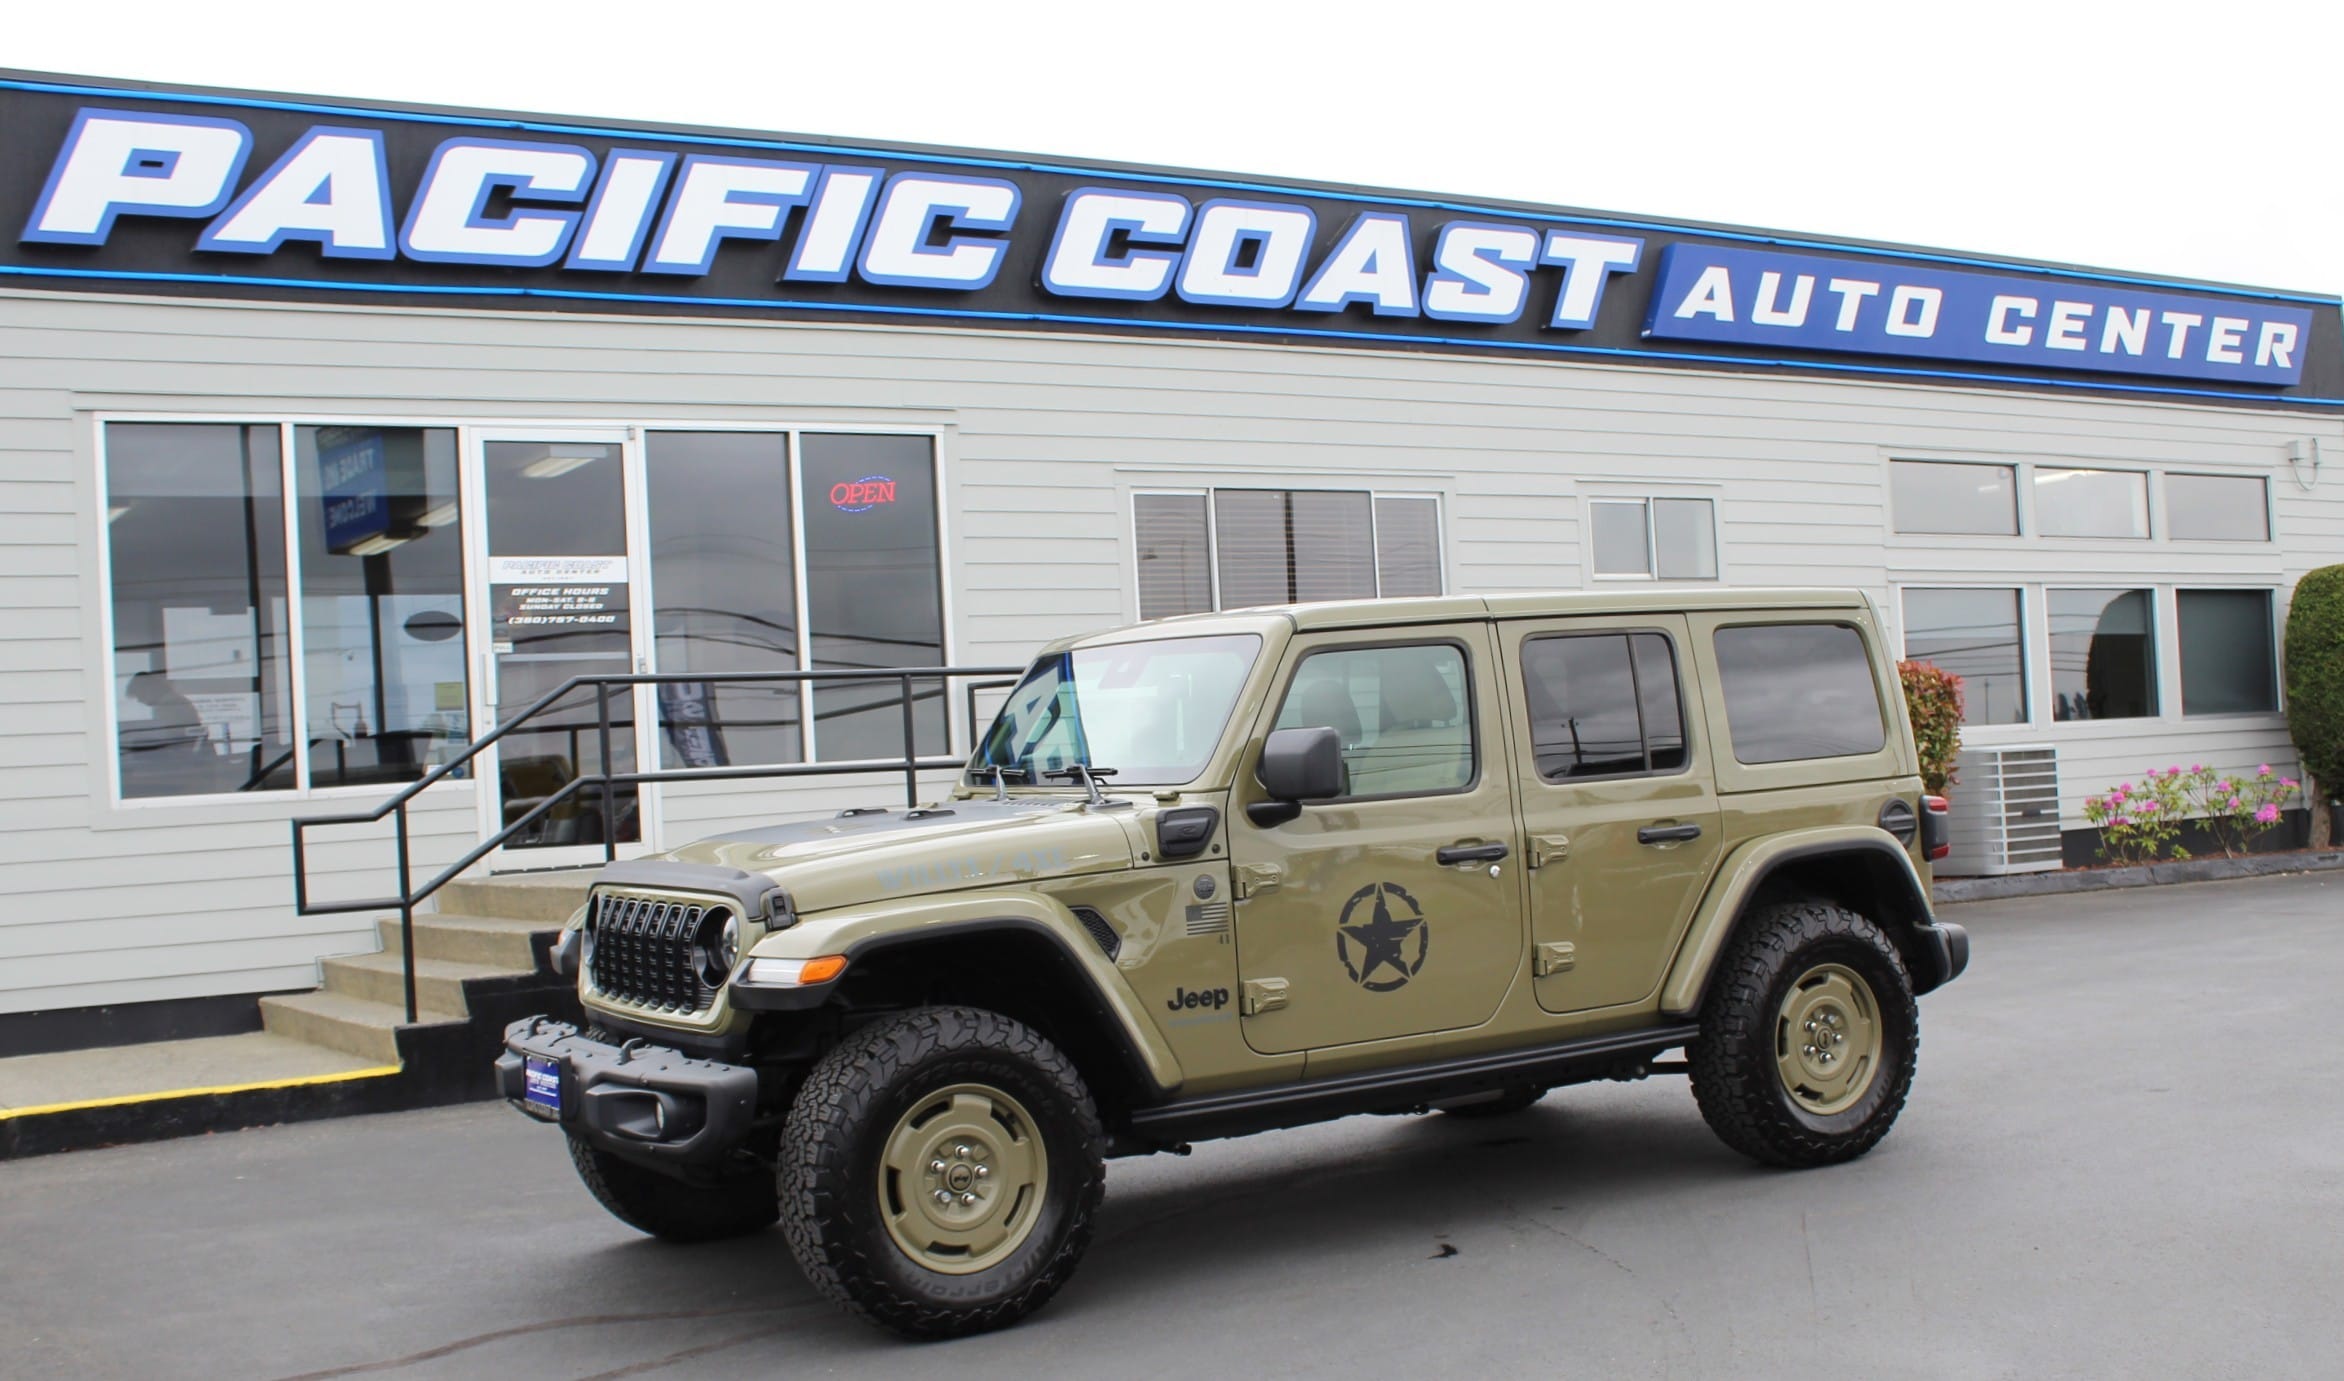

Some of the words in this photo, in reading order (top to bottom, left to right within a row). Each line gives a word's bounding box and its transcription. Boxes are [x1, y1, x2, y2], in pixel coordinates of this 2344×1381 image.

[20, 107, 1023, 290] PACIFIC
[1041, 187, 1644, 331] COAST
[1674, 265, 1943, 338] AUTO
[1985, 294, 2299, 368] CENTER
[829, 481, 897, 505] OPEN
[511, 588, 560, 596] OFFICE
[563, 587, 610, 596] HOURS
[562, 603, 605, 611] CLOSED
[1167, 987, 1230, 1011] Jeep
